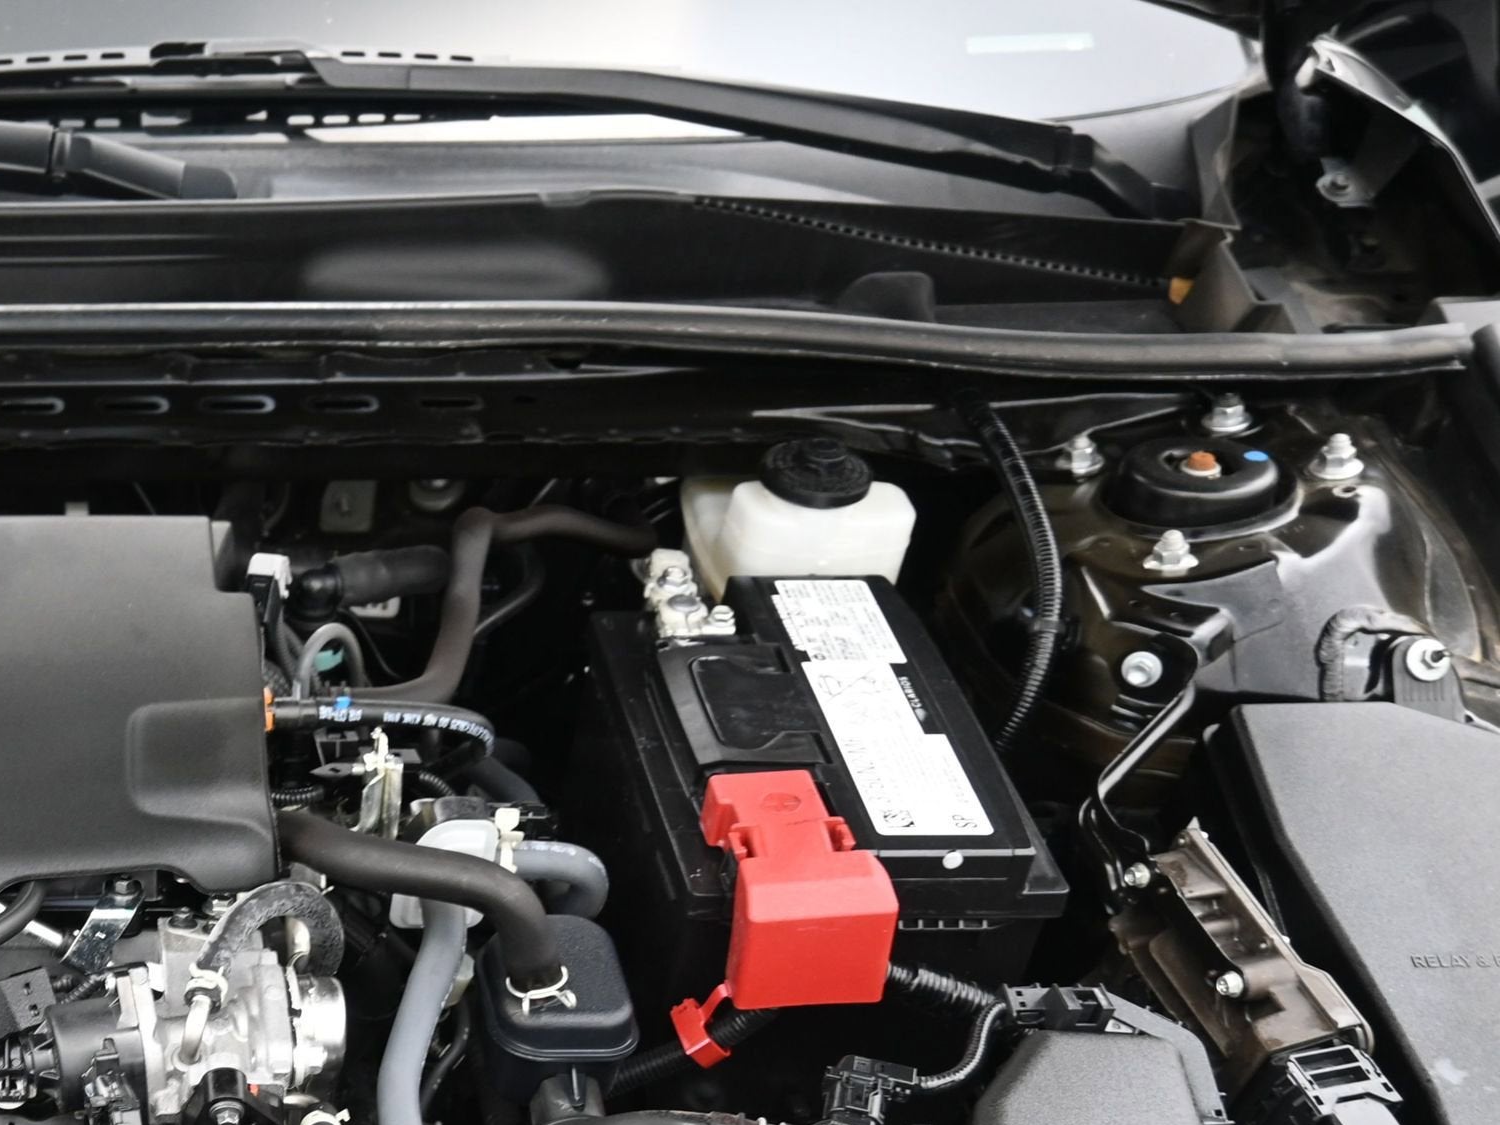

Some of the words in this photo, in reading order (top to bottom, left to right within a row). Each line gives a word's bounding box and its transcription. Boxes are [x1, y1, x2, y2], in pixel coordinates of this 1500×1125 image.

[898, 676, 922, 708] CLARIOS
[1410, 953, 1471, 968] RELAY
[1476, 954, 1491, 968] &
